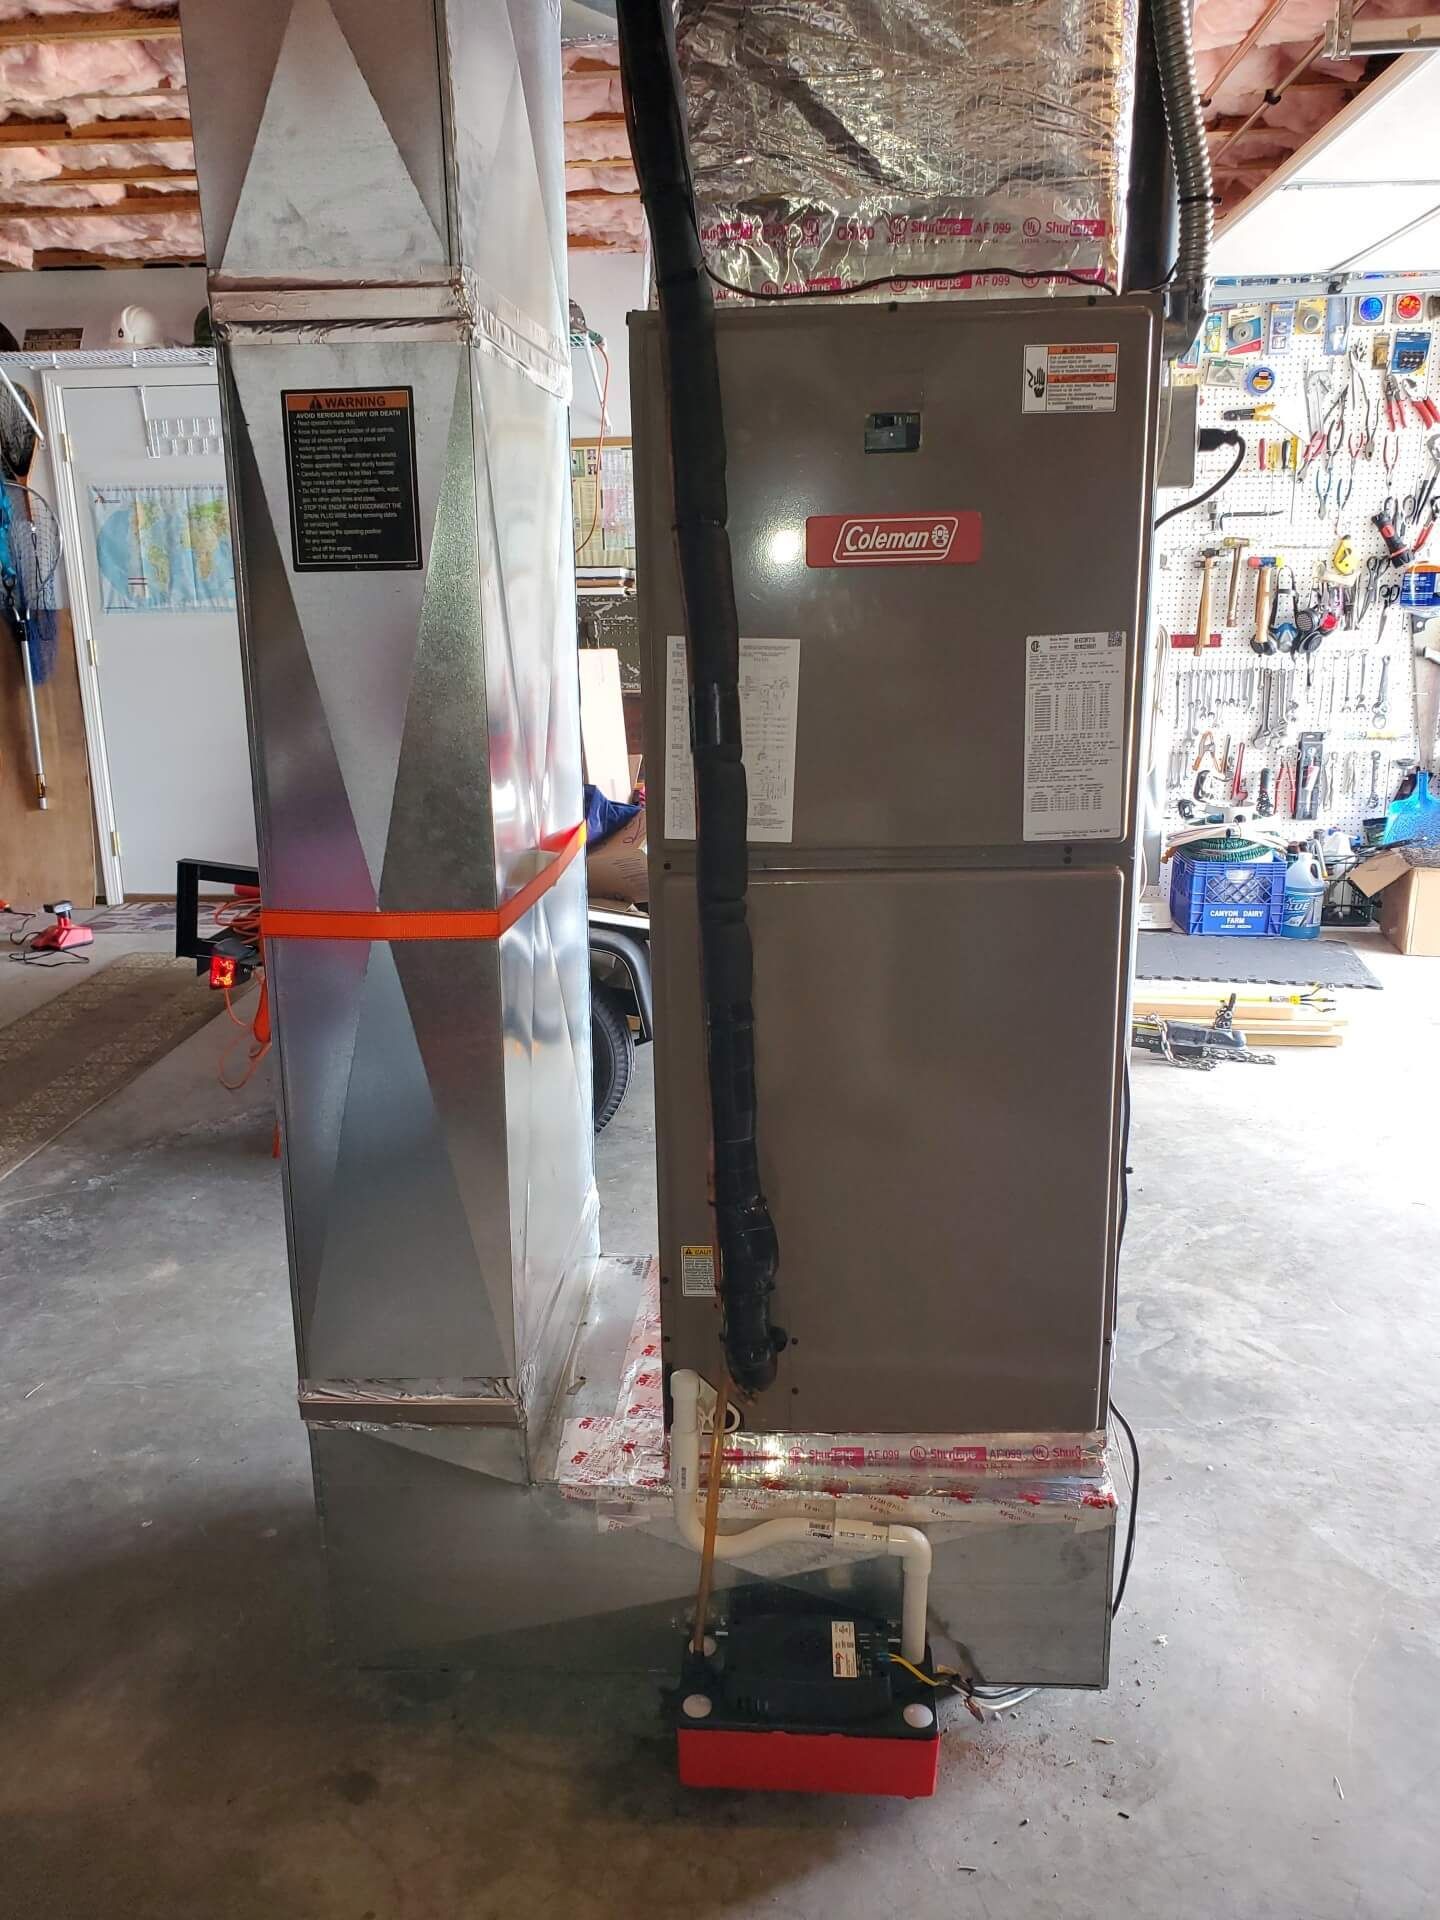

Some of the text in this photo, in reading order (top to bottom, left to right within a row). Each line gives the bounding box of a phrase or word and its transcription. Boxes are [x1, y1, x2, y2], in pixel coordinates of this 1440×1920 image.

[911, 221, 962, 235] Shurtape
[975, 222, 989, 234] AF
[992, 222, 1011, 234] 099
[1046, 222, 1096, 235] Shurtape
[975, 274, 988, 285] AF
[992, 274, 1010, 285] 099
[324, 395, 386, 407] WARNING
[846, 525, 929, 552] Coleman
[868, 1450, 880, 1460] AF
[883, 1449, 900, 1459] 099
[931, 1450, 977, 1459] Shurtape
[990, 1449, 1003, 1459] AF
[1004, 1449, 1022, 1459] 099
